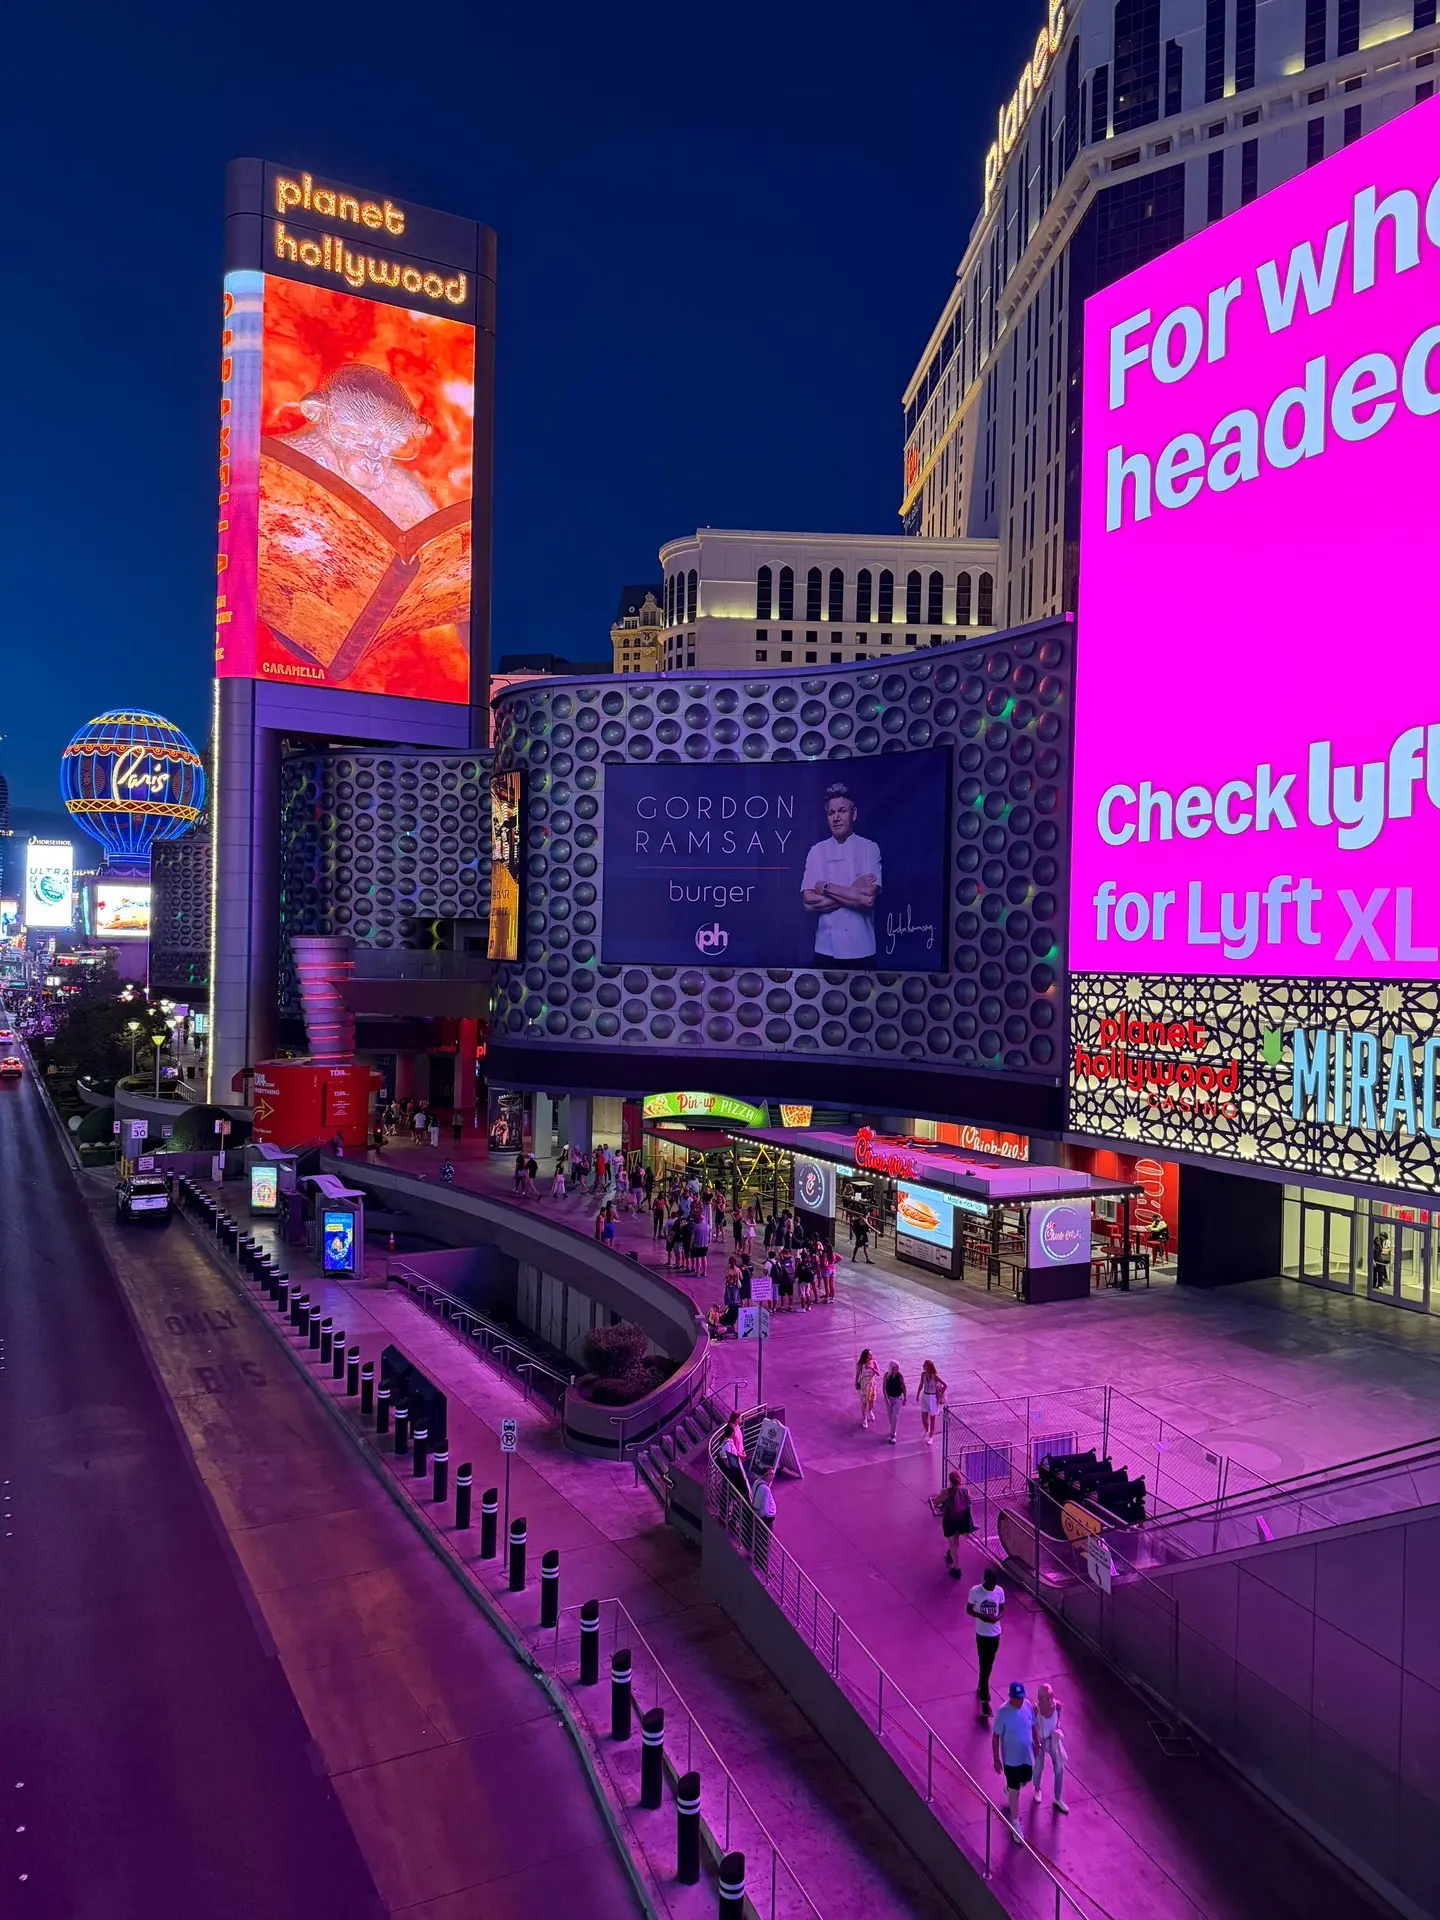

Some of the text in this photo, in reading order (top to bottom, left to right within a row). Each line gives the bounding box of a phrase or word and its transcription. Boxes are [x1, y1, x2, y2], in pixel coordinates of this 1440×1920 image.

[275, 172, 406, 236] planet
[274, 221, 468, 305] hollywood
[1108, 276, 1242, 411] For
[262, 661, 326, 680] CARAMELLA
[112, 744, 171, 805] Paris
[636, 794, 795, 820] GORDON
[1097, 762, 1298, 847] Check
[635, 829, 793, 854] RAMSAY
[29, 867, 70, 876] ULTRA
[668, 879, 755, 908] burger
[1093, 874, 1440, 962] for Lyft XL
[1099, 1009, 1208, 1050] planet
[1075, 1044, 1239, 1093] hollywood
[676, 1093, 755, 1121] Pin-up PIZZA
[1145, 1091, 1238, 1120] CASINO
[133, 1129, 146, 1138] 30
